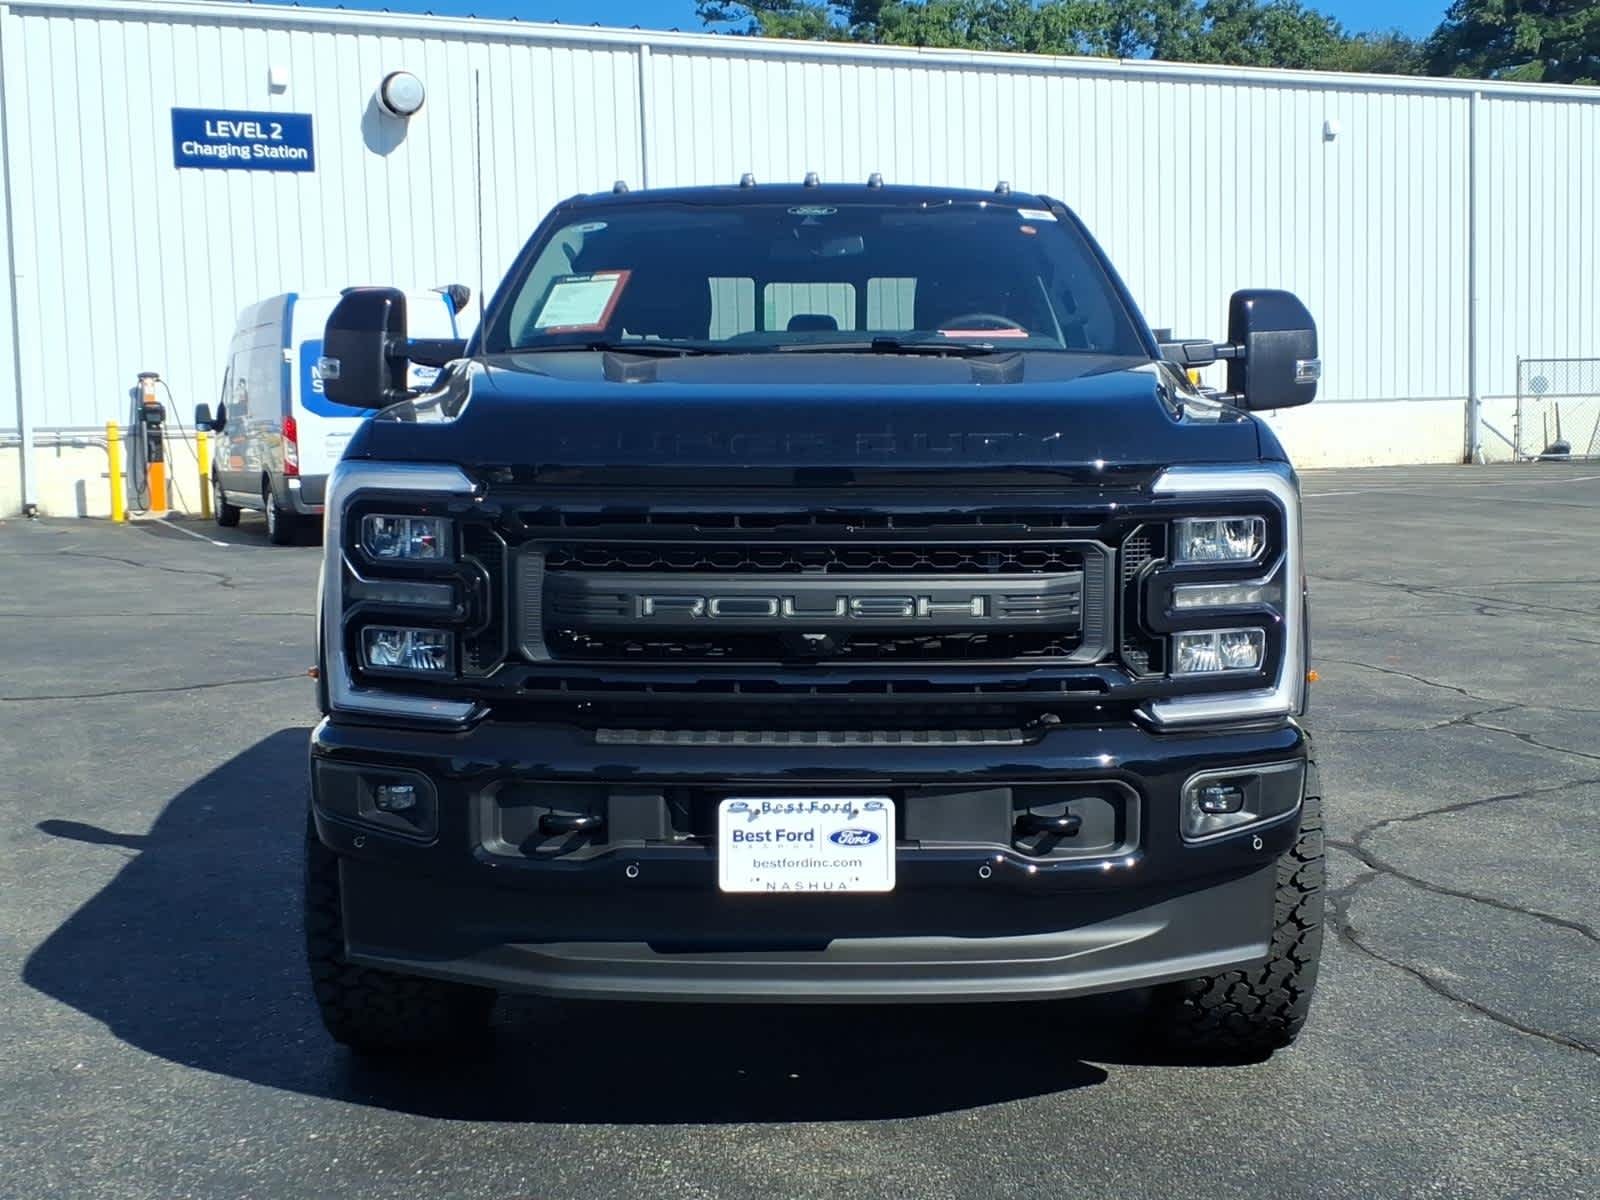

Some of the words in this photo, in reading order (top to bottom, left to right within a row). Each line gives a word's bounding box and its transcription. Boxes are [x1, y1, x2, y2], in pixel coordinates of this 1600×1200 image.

[205, 120, 268, 139] LEVEL
[270, 122, 283, 140] 2
[182, 141, 252, 159] Charging
[253, 143, 308, 159] Station
[635, 594, 991, 620] ROUSH
[761, 801, 804, 813] Best
[810, 801, 853, 813] Ford
[732, 829, 773, 842] Best
[776, 828, 815, 842] Ford
[752, 857, 863, 868] bestfordinc.com
[766, 881, 848, 891] NASHUA
